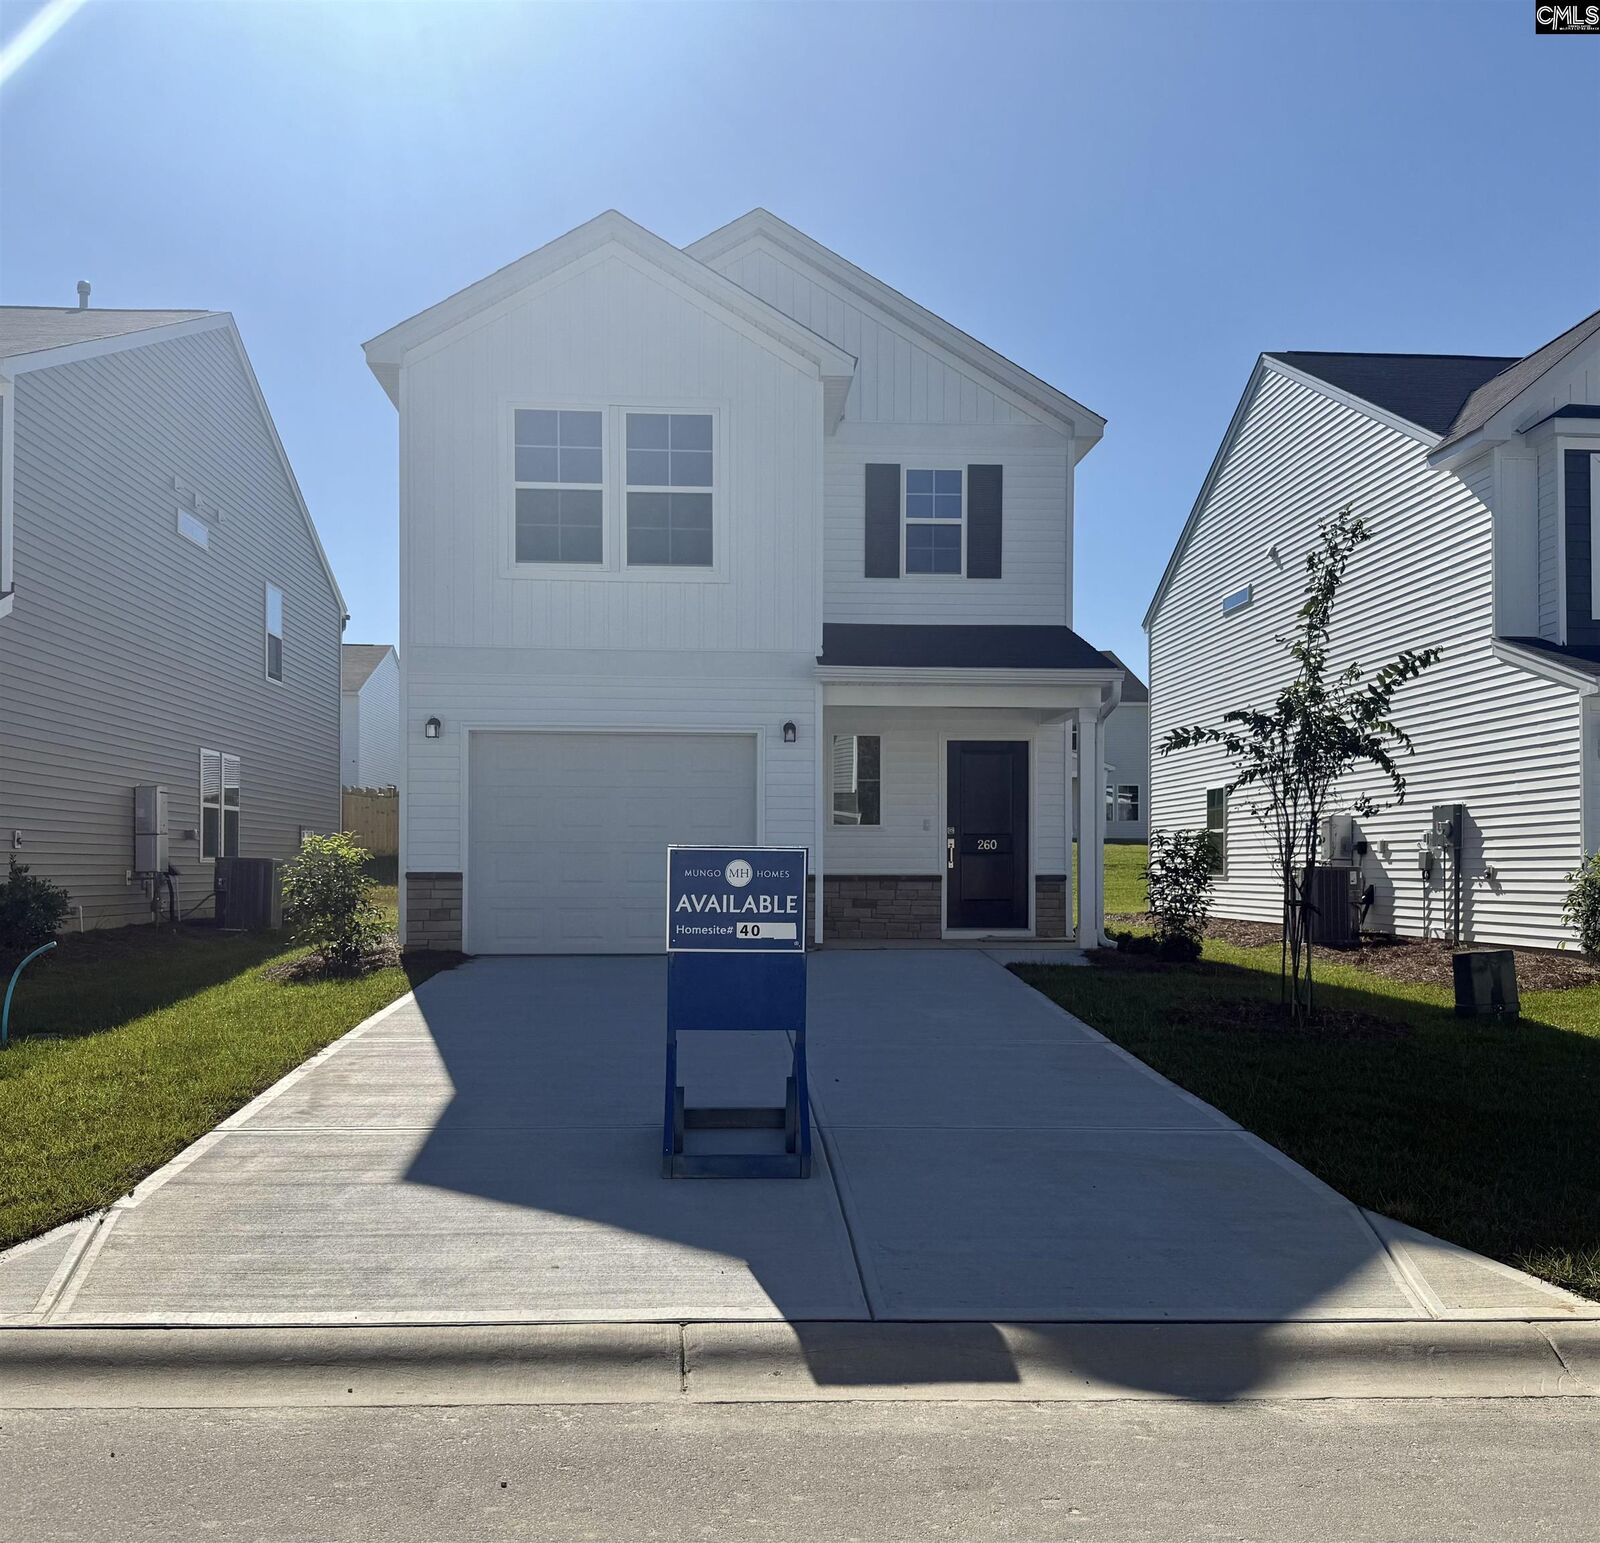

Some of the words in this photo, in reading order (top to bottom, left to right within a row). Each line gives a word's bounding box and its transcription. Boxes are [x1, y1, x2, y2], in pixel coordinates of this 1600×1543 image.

[977, 839, 997, 850] 260
[684, 869, 721, 877] MUNGO
[728, 868, 750, 878] MH
[756, 869, 790, 878] HOMES
[675, 894, 798, 914] AVAILABLE
[676, 924, 734, 935] Homesite#
[739, 924, 760, 937] 40
